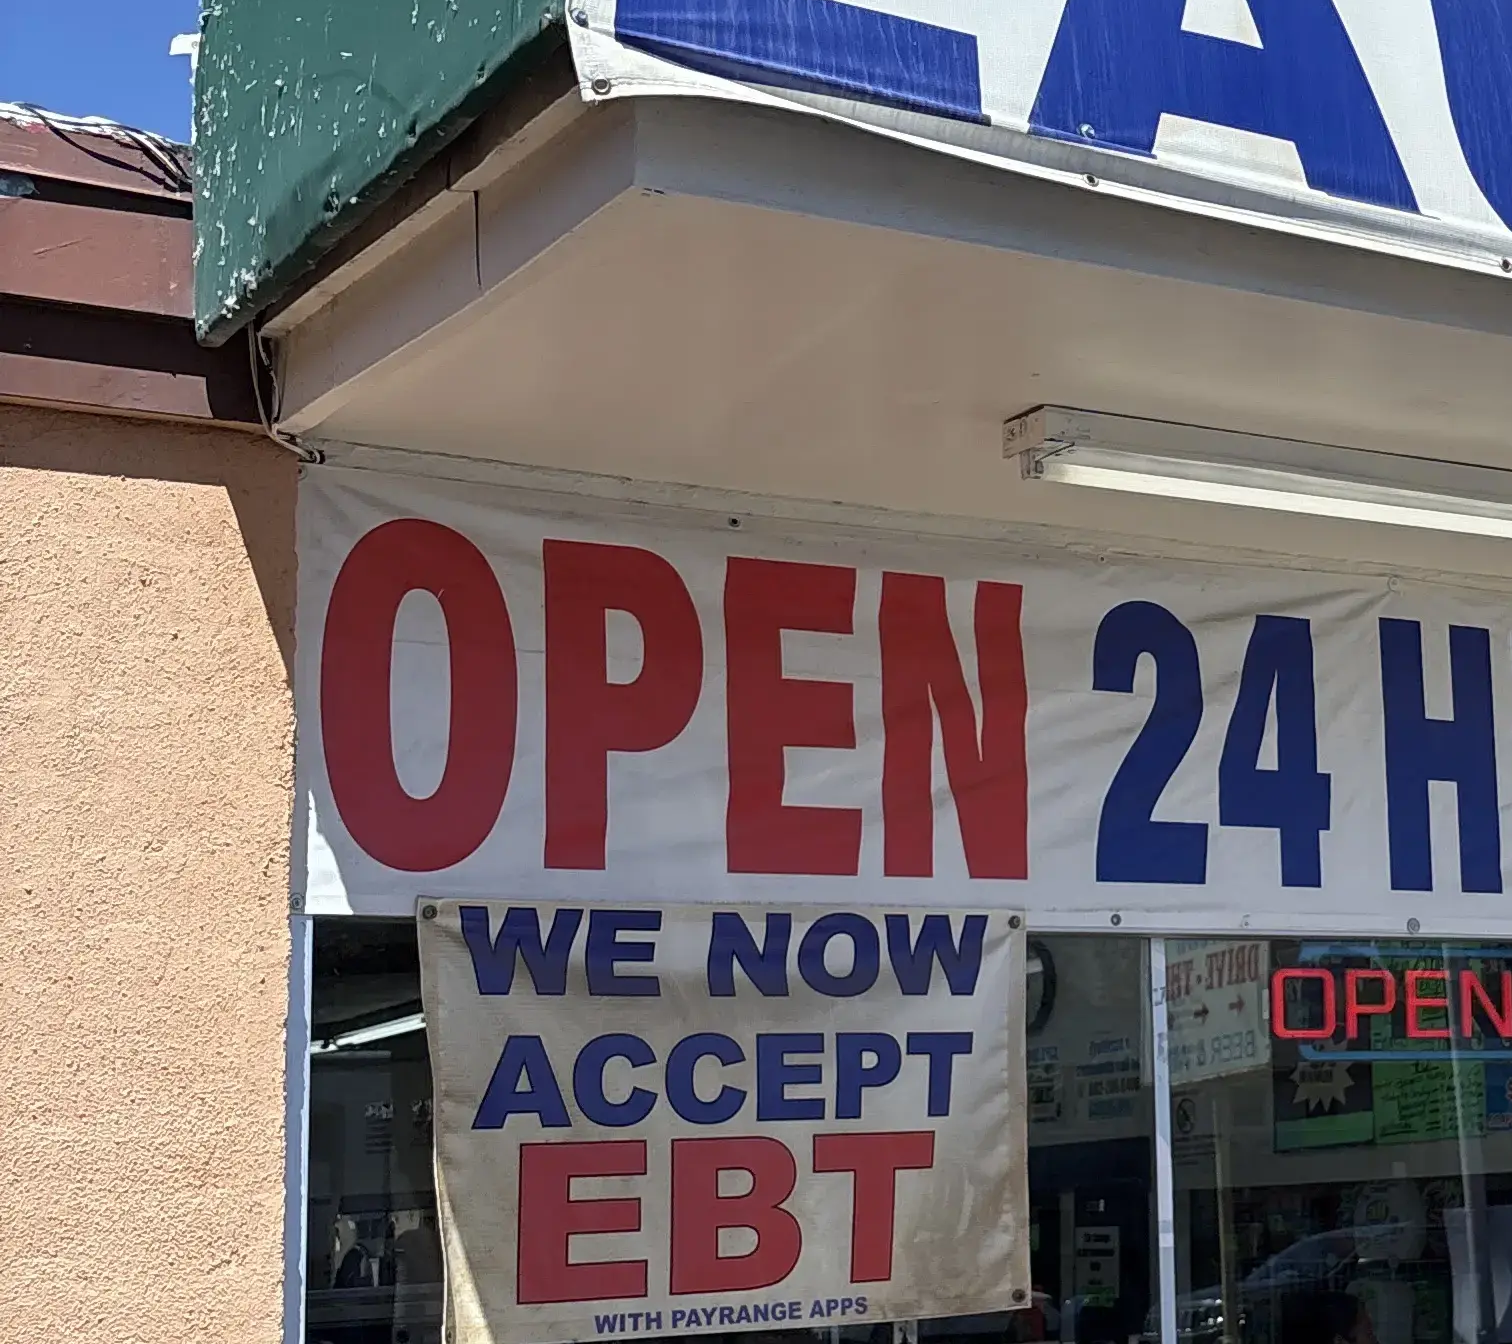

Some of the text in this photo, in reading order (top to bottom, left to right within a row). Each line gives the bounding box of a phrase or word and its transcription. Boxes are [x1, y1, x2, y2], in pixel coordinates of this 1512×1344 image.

[320, 517, 1029, 880] OPEN
[1092, 600, 1332, 889] 24
[459, 906, 987, 998] WE NOW
[471, 1031, 974, 1131] ACCEPT
[516, 1130, 936, 1306] EBT
[594, 1296, 869, 1335] WITH PAYRANGE APPS
